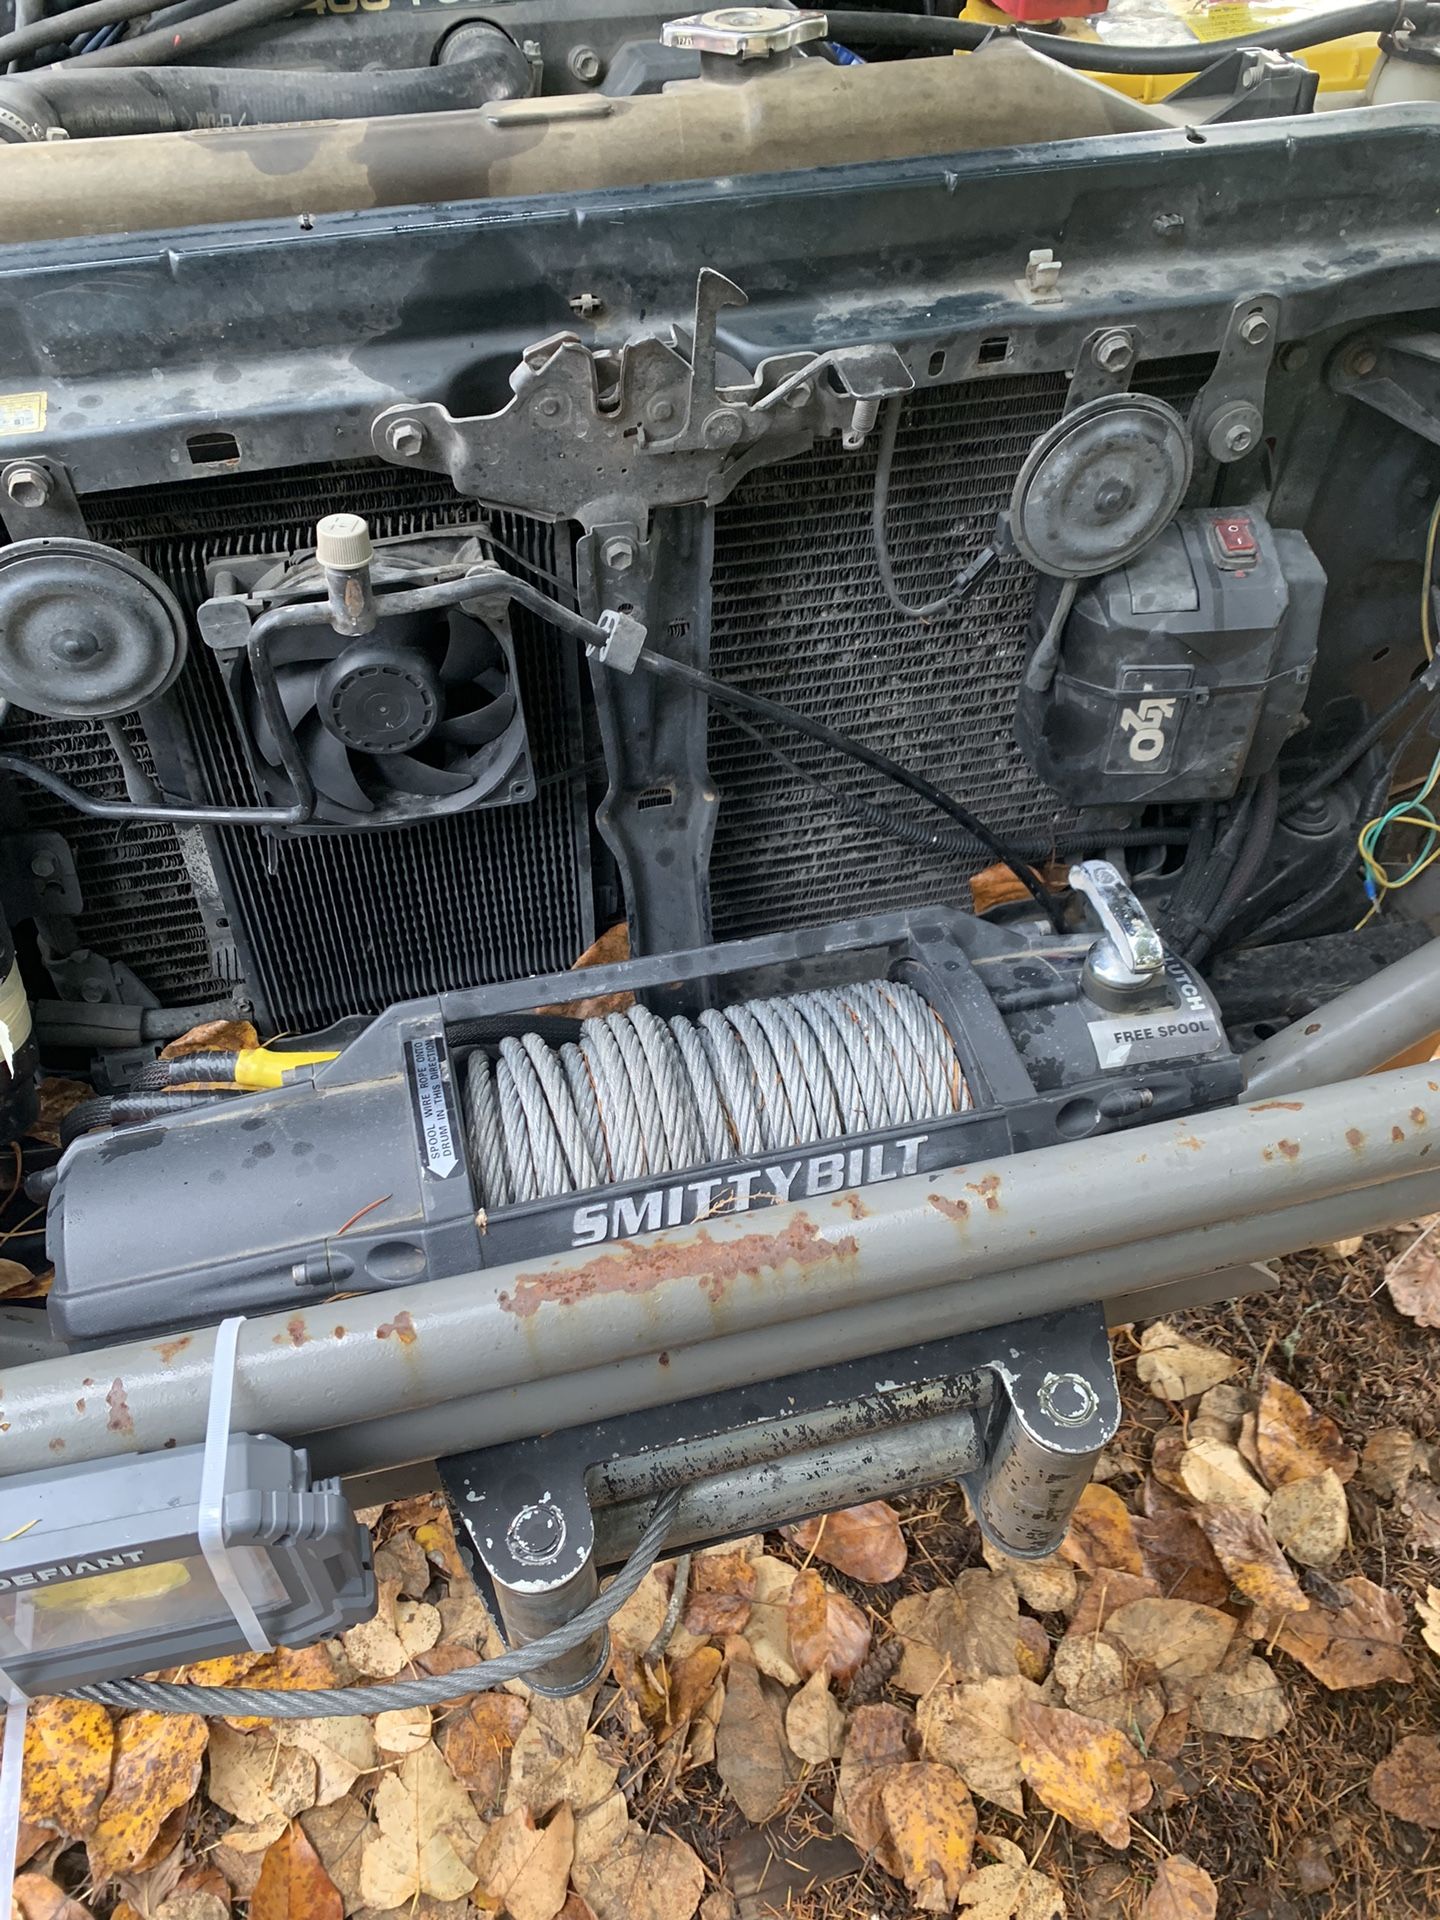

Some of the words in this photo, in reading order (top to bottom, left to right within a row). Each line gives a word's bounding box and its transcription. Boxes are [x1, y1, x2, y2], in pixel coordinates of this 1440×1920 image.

[1163, 948, 1206, 1011] LUTCH
[1113, 1028, 1154, 1044] FREE
[1157, 1020, 1210, 1038] SPOOL
[414, 1041, 425, 1063] ONTO
[424, 1039, 440, 1080] DIRECTION
[417, 1067, 429, 1088] ROPE
[422, 1093, 434, 1118] WIRE
[432, 1084, 443, 1105] THIS
[436, 1109, 446, 1121] IN
[427, 1124, 440, 1160] SPOOL
[438, 1125, 452, 1157] DRUM
[571, 1135, 929, 1247] SMITTYBILT
